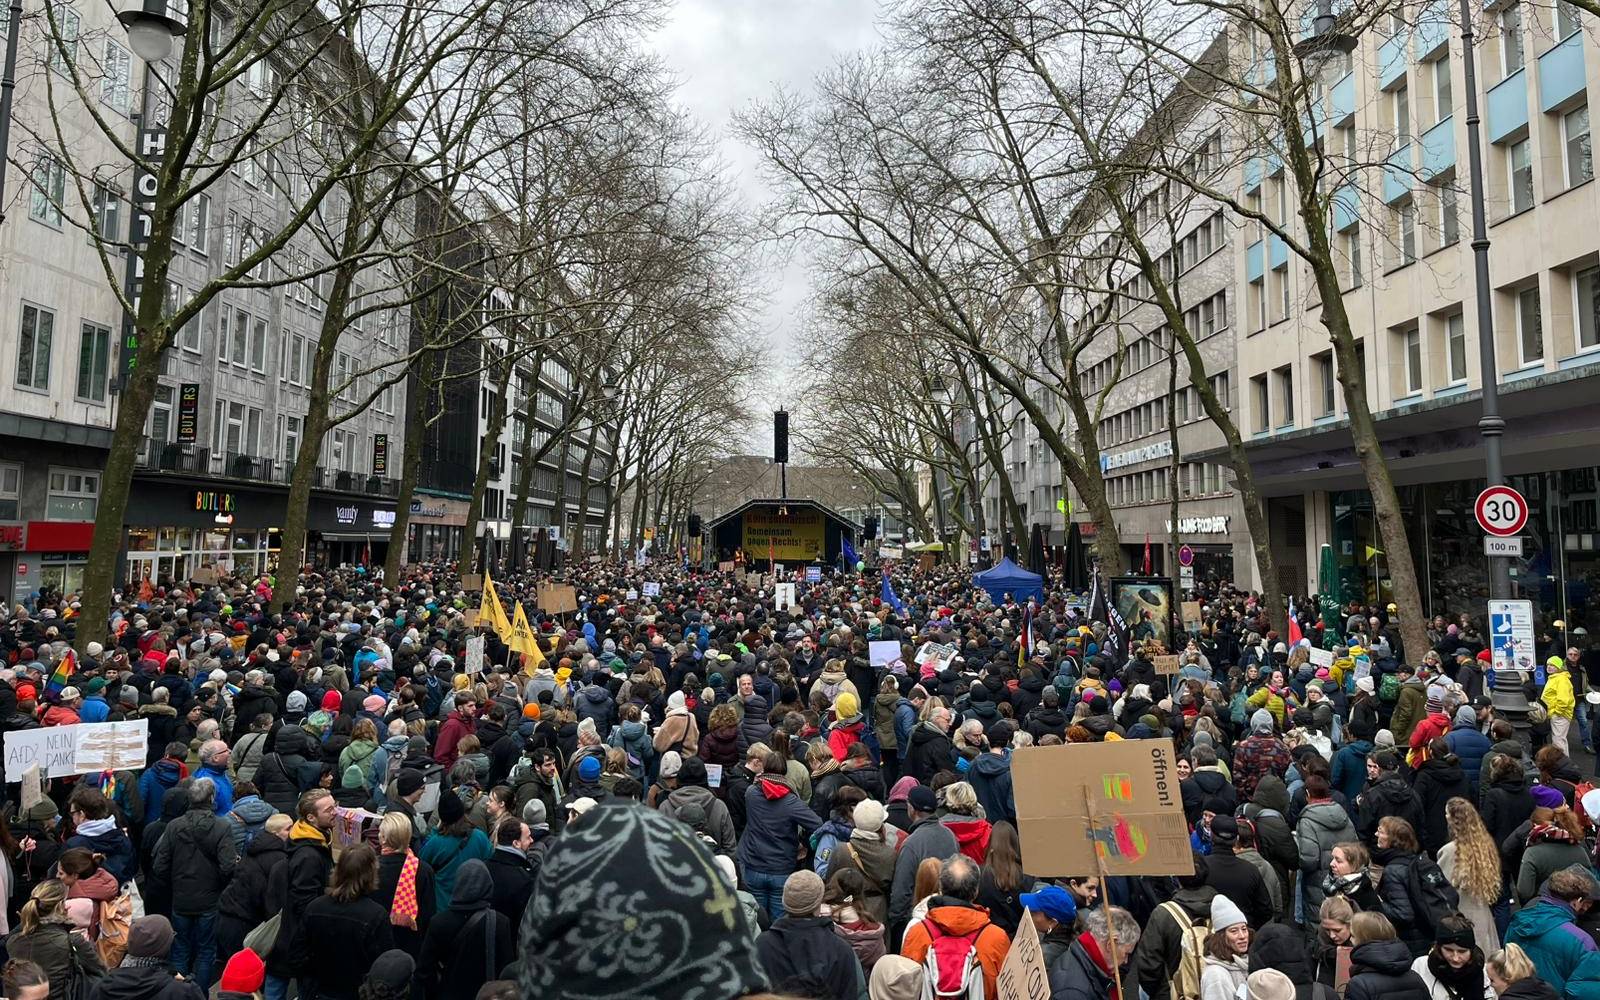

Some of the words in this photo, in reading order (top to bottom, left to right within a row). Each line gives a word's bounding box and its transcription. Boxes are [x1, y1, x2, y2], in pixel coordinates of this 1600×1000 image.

[181, 387, 196, 434] BUTLERS
[375, 436, 386, 469] BUTLERS
[196, 491, 236, 512] BUTLERS
[1486, 500, 1516, 522] 30
[747, 527, 792, 536] Gemeinsam
[747, 537, 770, 546] gegen
[772, 537, 801, 546] Rechts!
[1490, 543, 1506, 551] 100
[46, 733, 73, 750] NEIN
[8, 743, 39, 766] AfD?
[45, 750, 76, 768] DANKE
[1151, 748, 1173, 806] öffnen!
